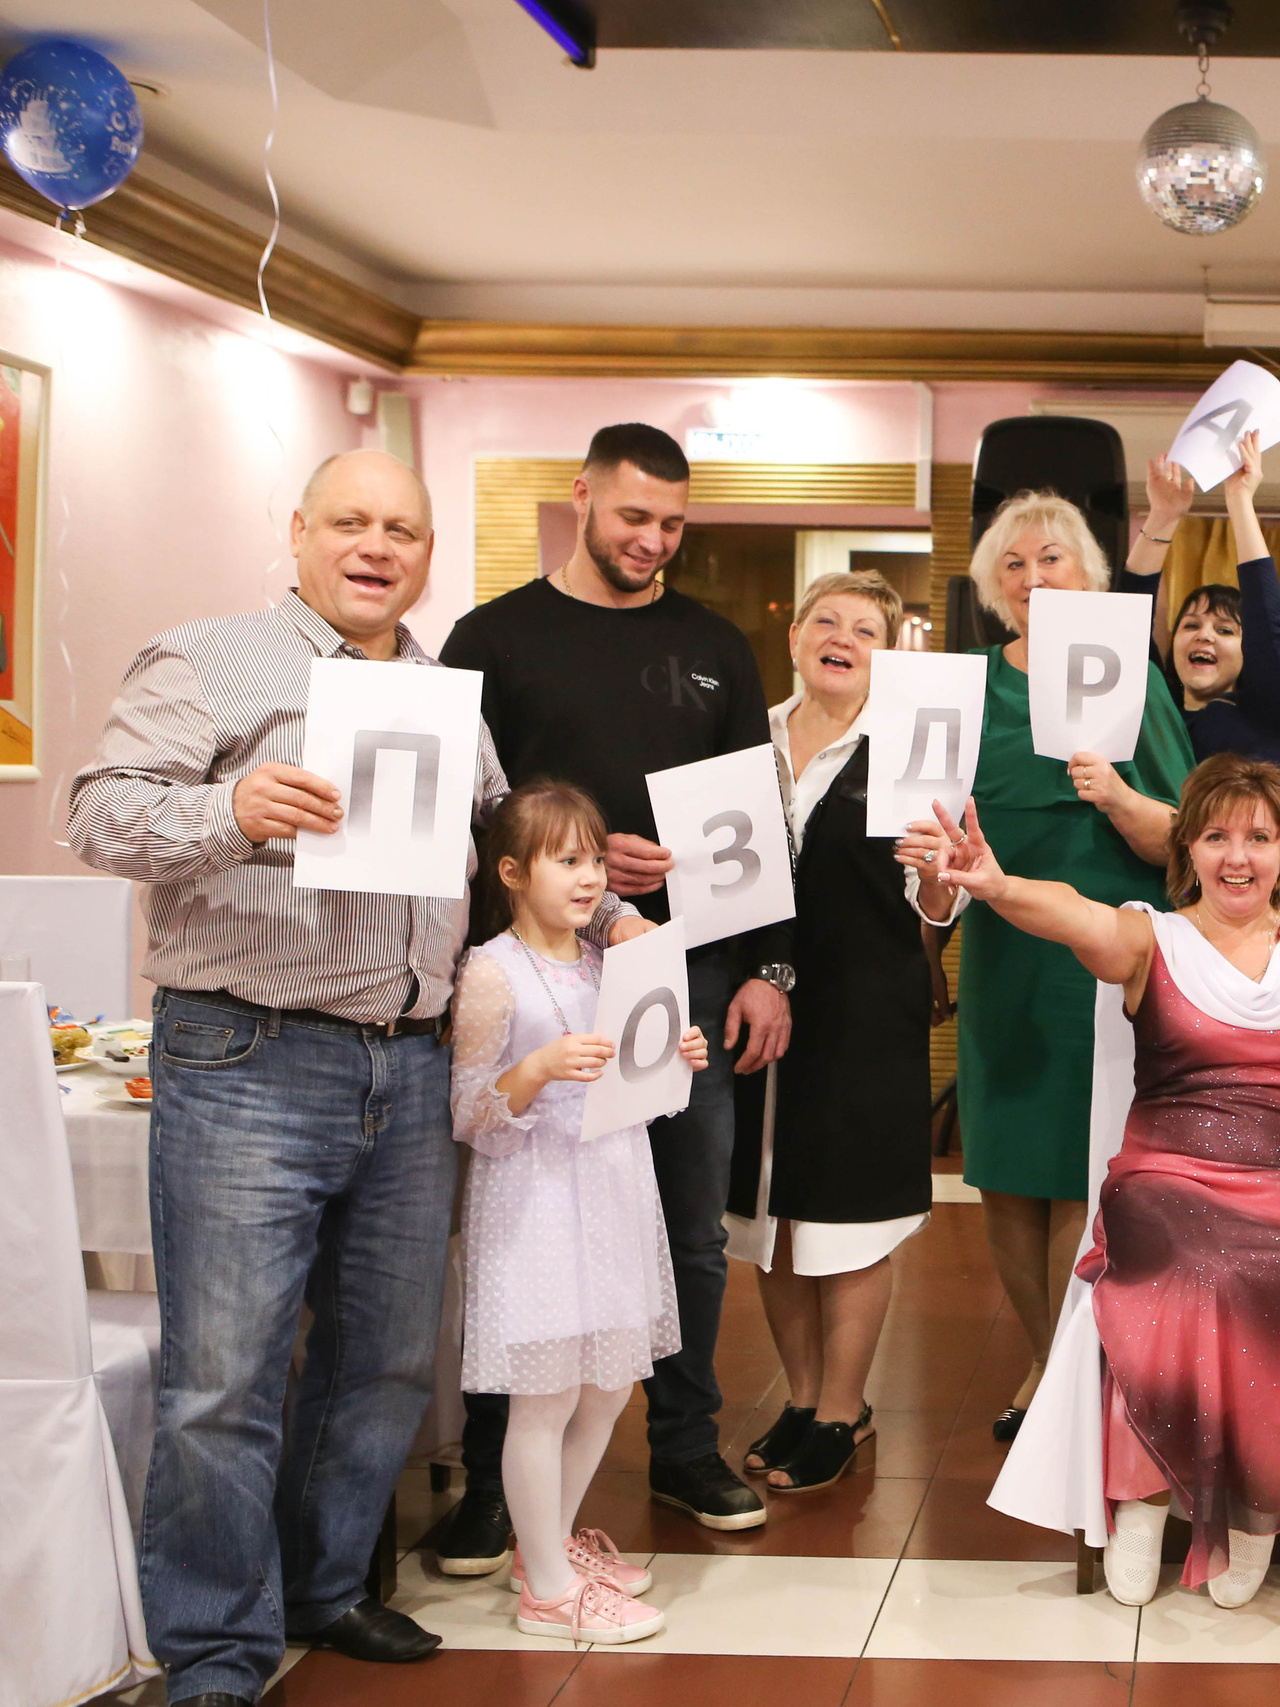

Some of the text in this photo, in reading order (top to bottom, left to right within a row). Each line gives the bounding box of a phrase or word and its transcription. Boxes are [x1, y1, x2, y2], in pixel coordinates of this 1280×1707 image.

[1181, 398, 1253, 456] А
[1065, 643, 1122, 725] Р
[347, 729, 442, 842] П
[893, 707, 964, 806] Д
[702, 809, 762, 900] З
[618, 986, 682, 1084] О
